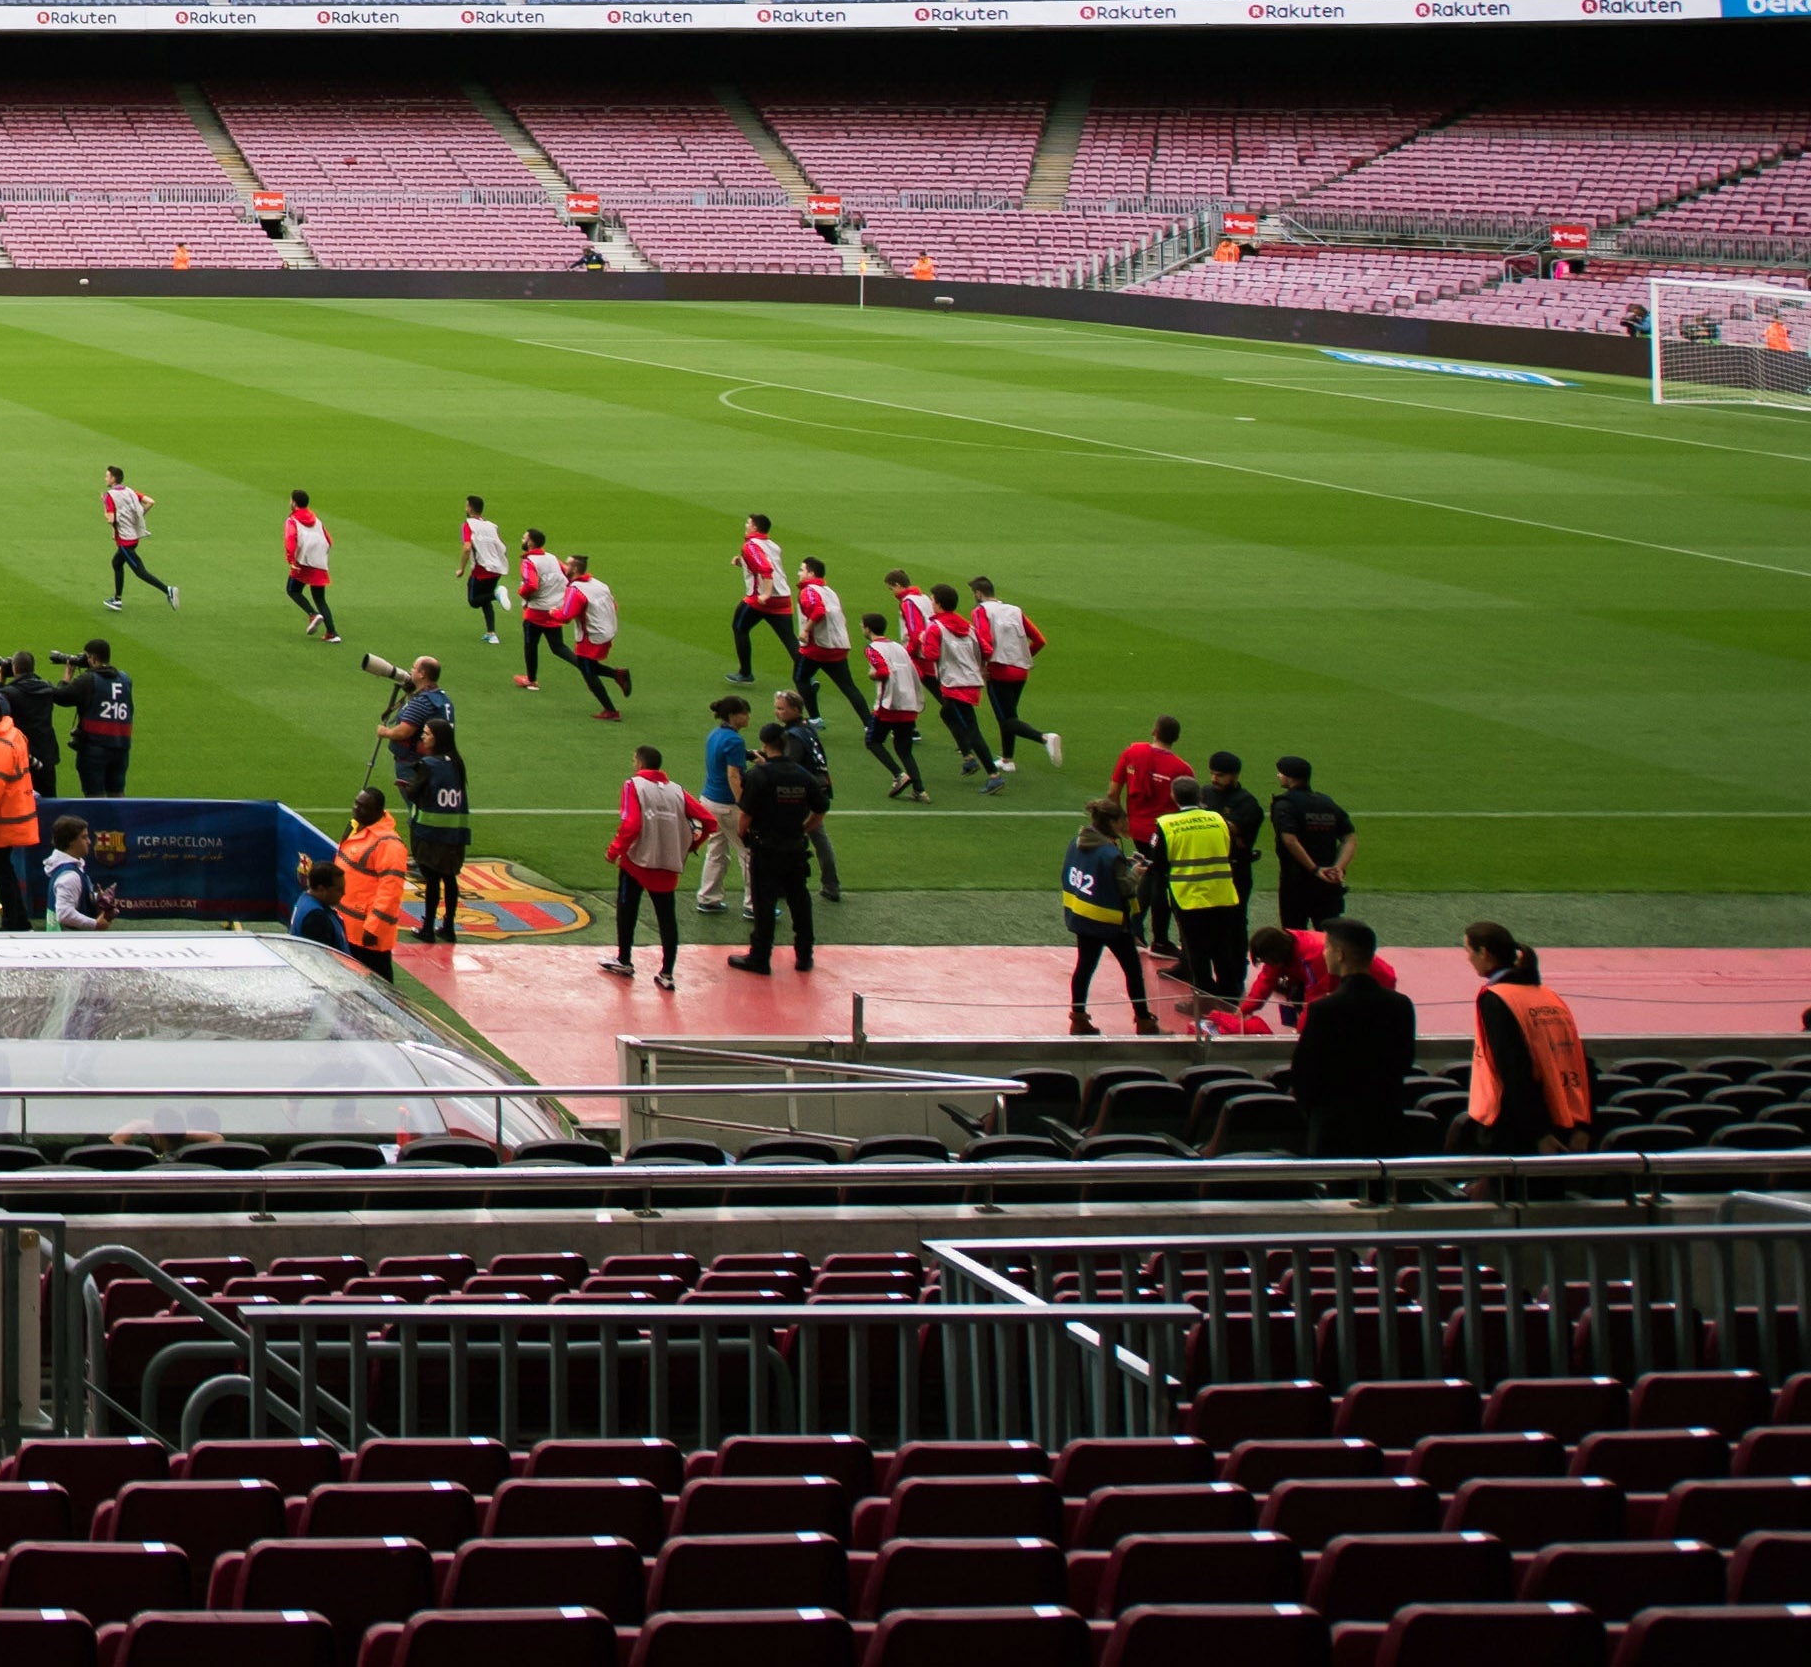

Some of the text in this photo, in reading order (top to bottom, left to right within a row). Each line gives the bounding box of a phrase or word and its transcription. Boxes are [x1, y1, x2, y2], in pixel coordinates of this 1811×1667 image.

[622, 9, 693, 24] Rakuten
[772, 8, 846, 23] Rakuten
[931, 6, 1009, 21] Rakuten
[1096, 5, 1177, 20] Rakuten
[1265, 3, 1345, 19] Rakuten
[1431, 1, 1511, 17] Rakuten
[50, 10, 117, 25] Rakuten
[189, 10, 257, 25] Rakuten
[331, 10, 400, 24] Rakuten
[475, 10, 545, 24] Rakuten
[111, 682, 123, 700] F
[99, 701, 128, 720] 216
[437, 788, 462, 808] 001
[137, 835, 224, 847] FCBARCELONA
